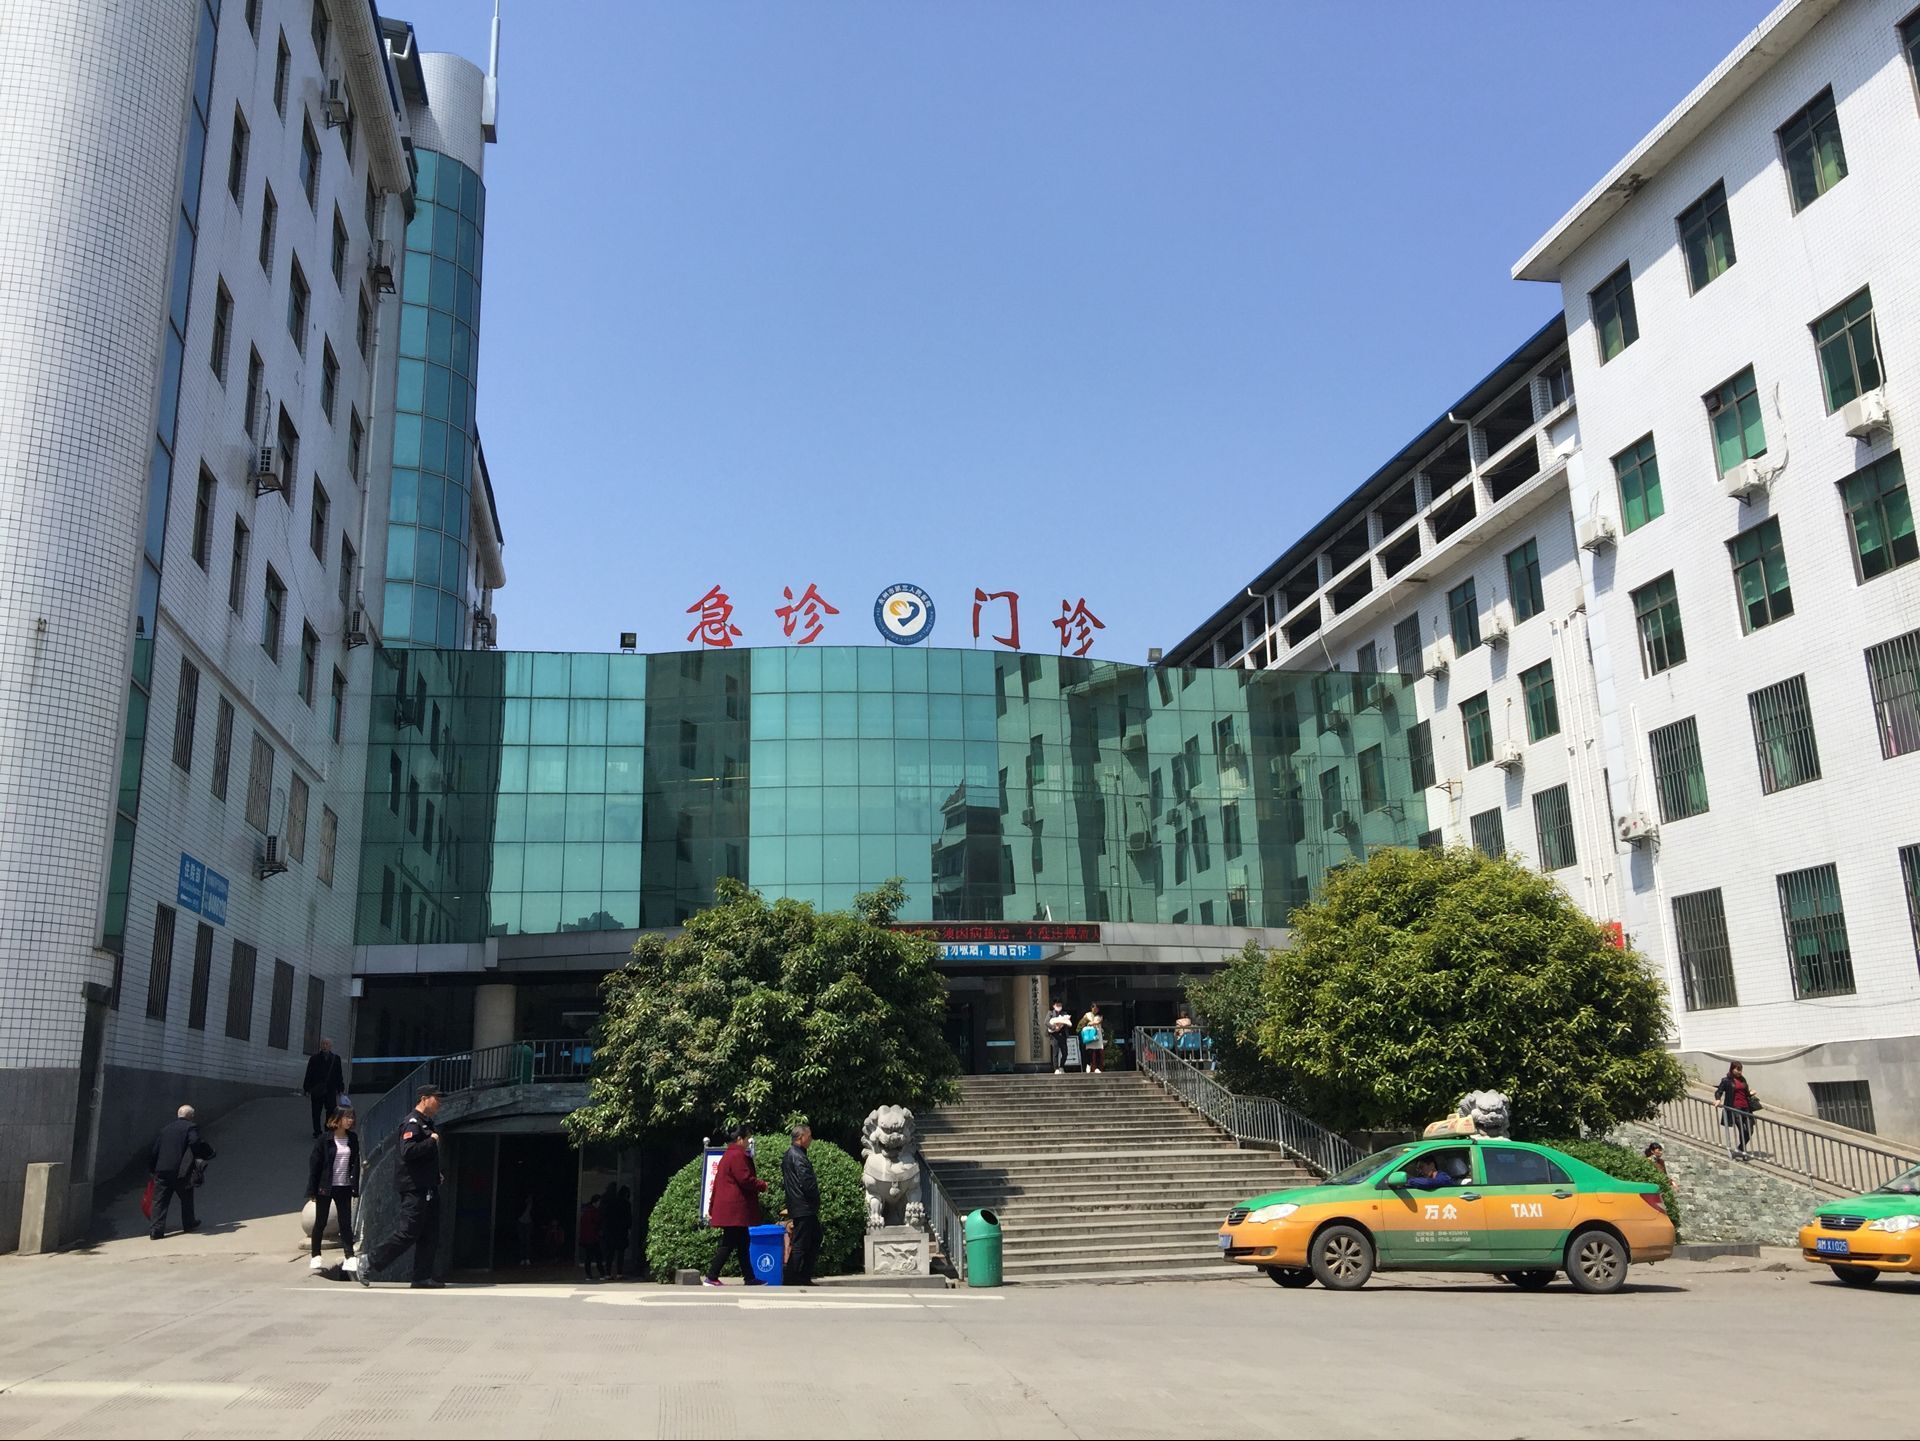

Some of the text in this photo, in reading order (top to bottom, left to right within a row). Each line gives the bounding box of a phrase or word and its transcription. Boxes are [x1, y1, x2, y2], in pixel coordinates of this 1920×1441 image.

[686, 583, 840, 647] 急诊
[972, 587, 1106, 656] 门诊
[1424, 1203, 1457, 1220] 万众
[1510, 1203, 1543, 1218] TAXI
